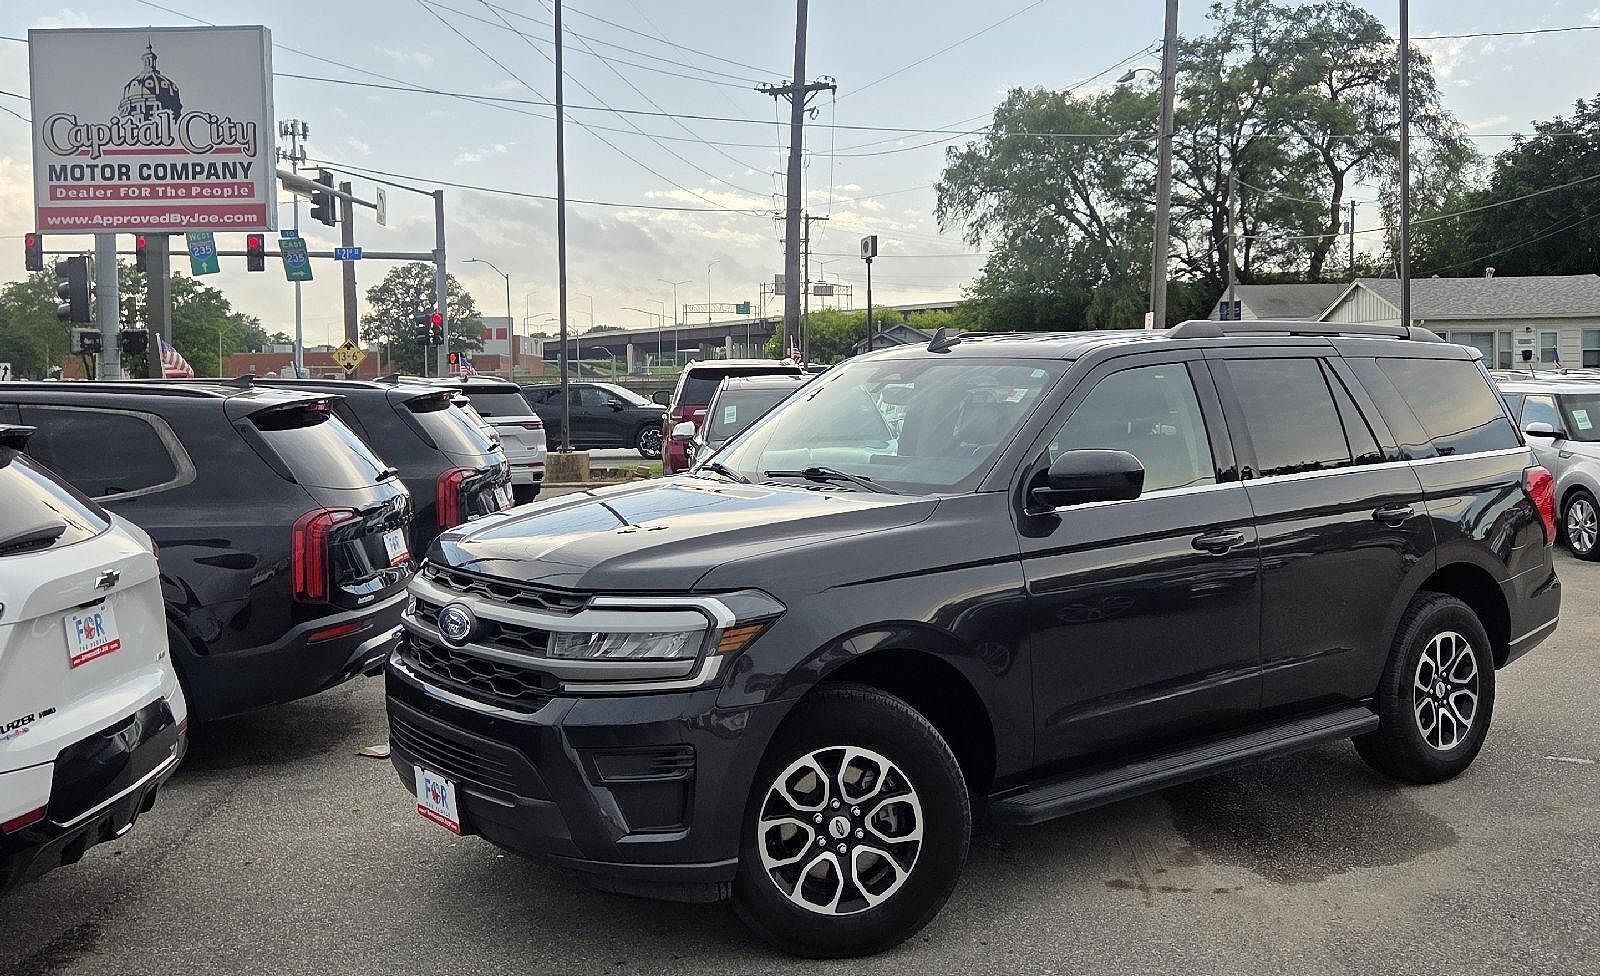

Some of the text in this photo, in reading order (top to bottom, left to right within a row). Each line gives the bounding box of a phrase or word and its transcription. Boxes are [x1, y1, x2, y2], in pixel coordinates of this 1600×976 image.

[43, 110, 257, 160] Capital City
[48, 161, 253, 181] MOTOR COMPANY
[56, 185, 249, 198] Dealer FOR The People
[47, 212, 258, 226] www.ApprovedByJoe.com
[192, 245, 213, 256] 235
[282, 240, 302, 248] EAST
[285, 253, 305, 263] 235
[0, 713, 35, 735] LAZER
